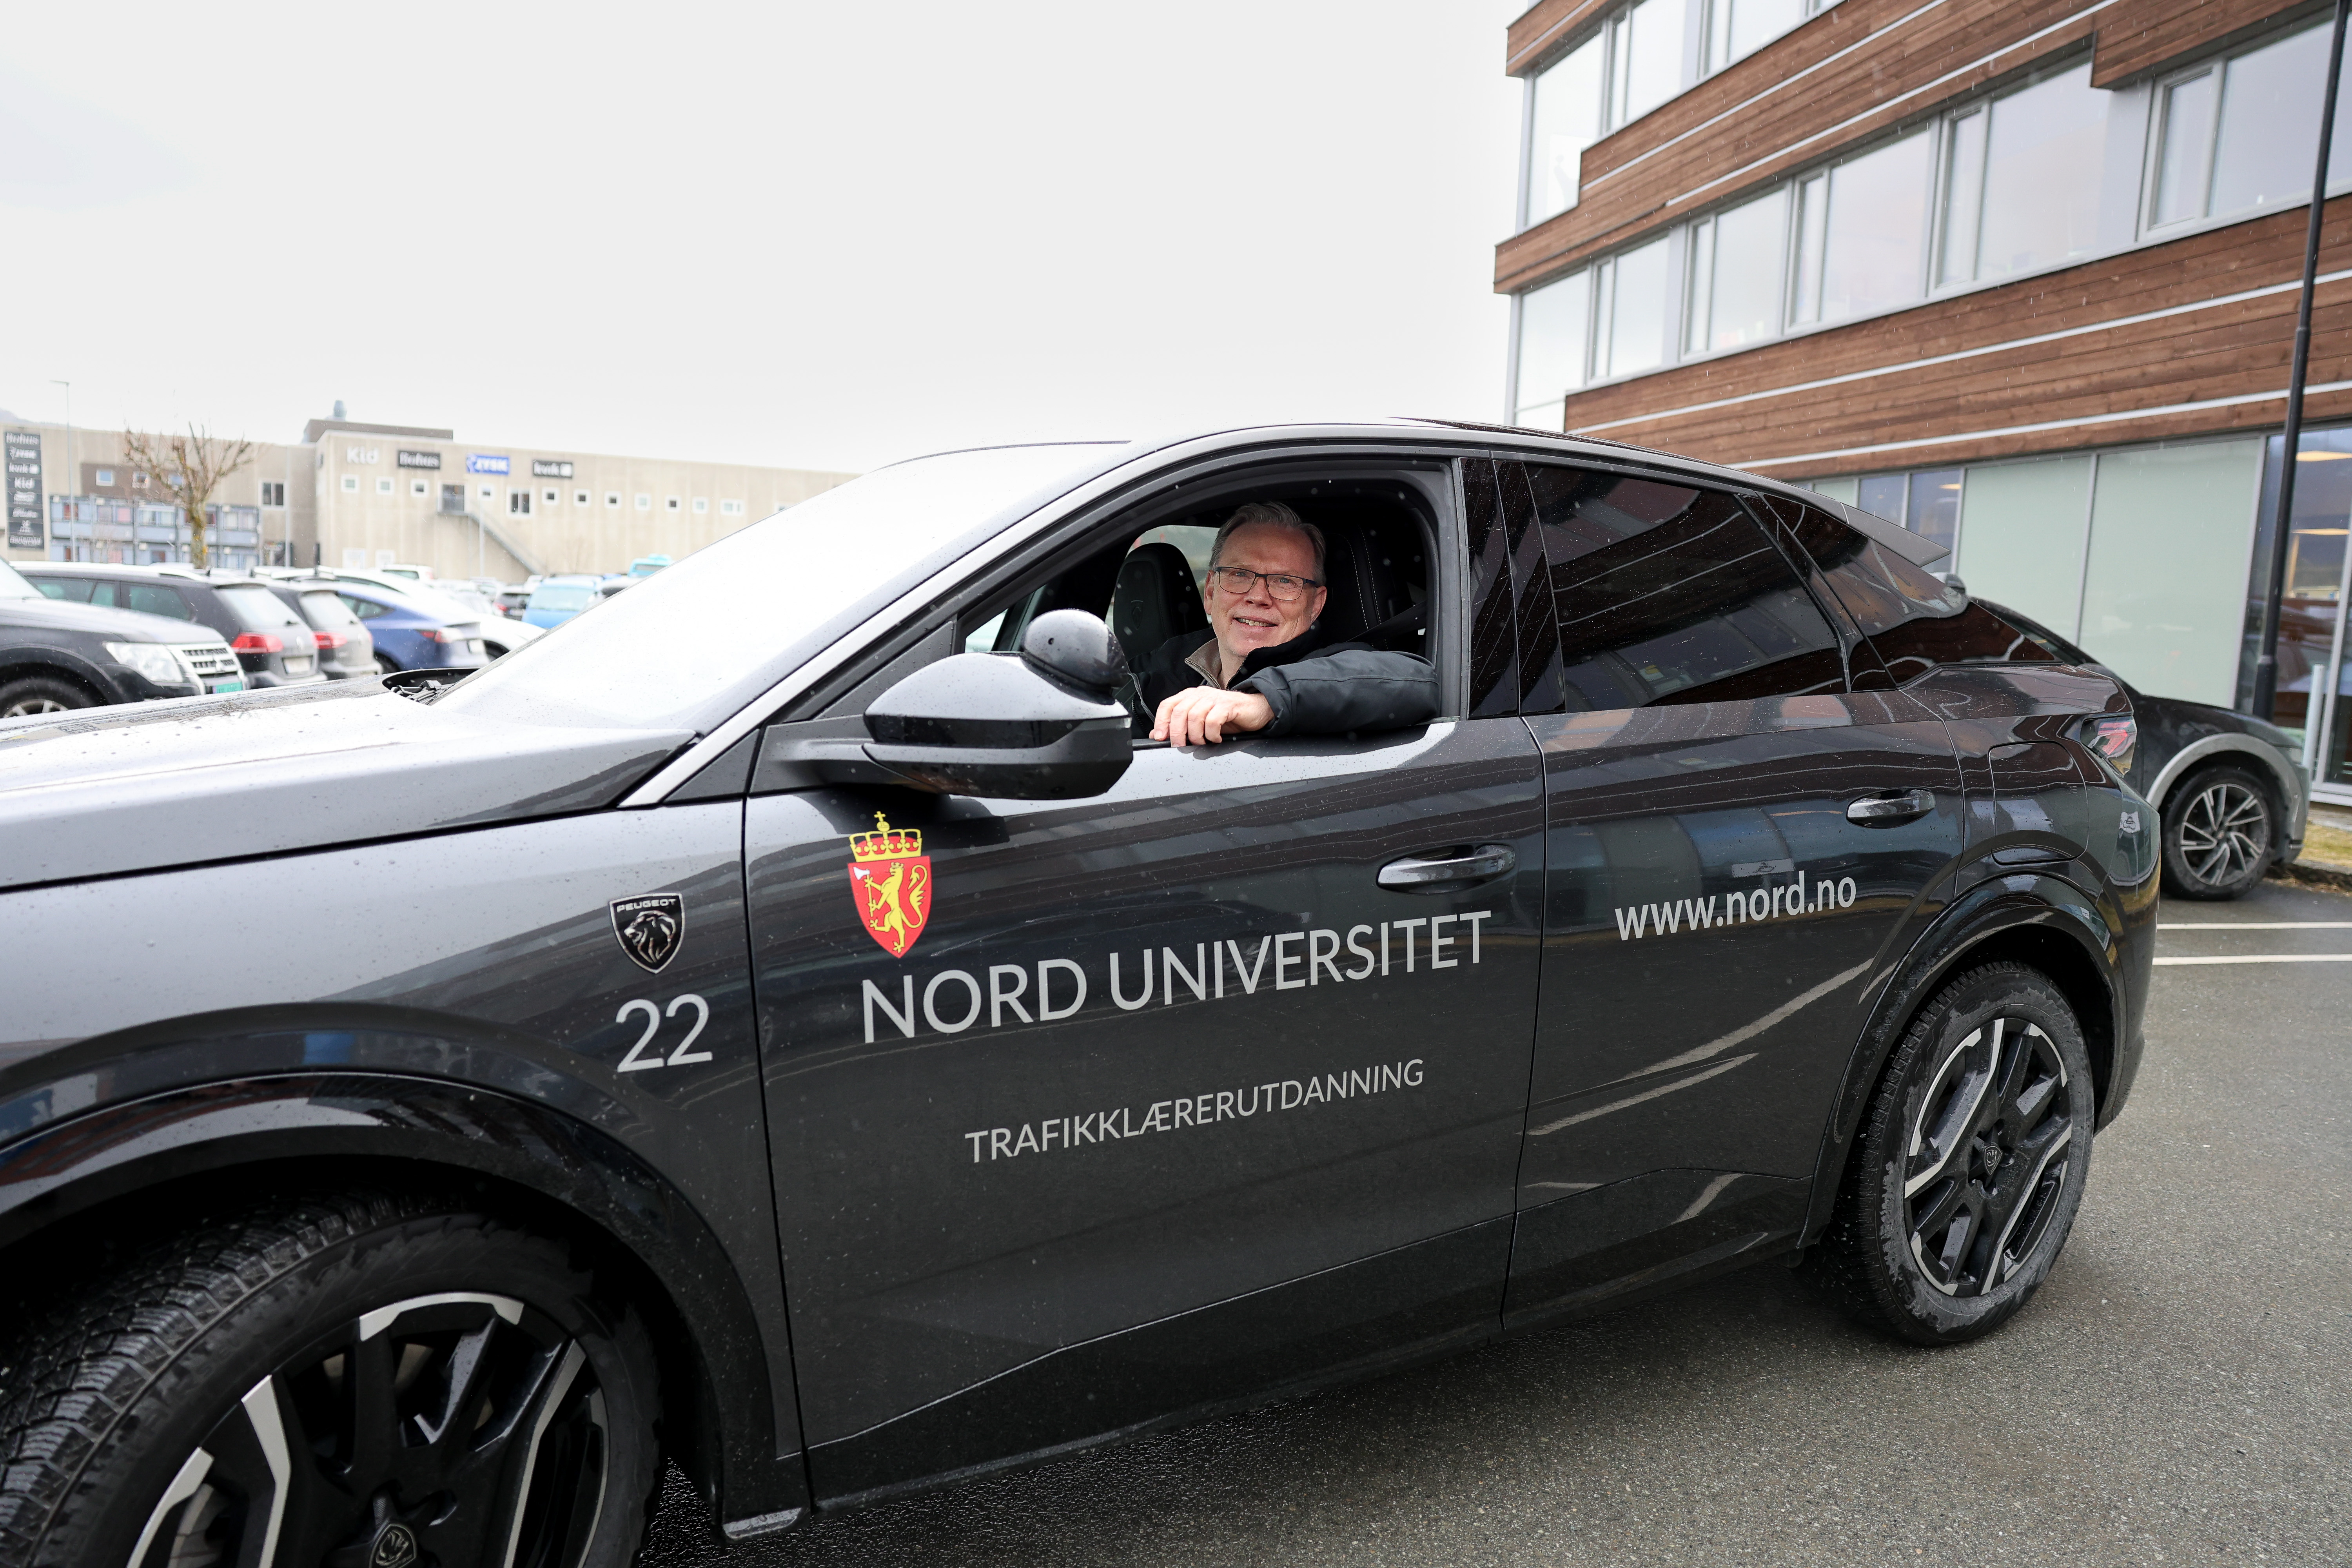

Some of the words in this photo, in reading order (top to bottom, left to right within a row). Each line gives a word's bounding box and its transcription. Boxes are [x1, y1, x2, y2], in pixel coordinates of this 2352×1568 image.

[346, 446, 379, 464] Kid
[399, 452, 439, 467] Bohus
[474, 457, 509, 471] JYSK
[617, 898, 676, 913] PEUGEOT
[1615, 870, 1856, 941] www.nord.no
[862, 958, 1087, 1044] NORD
[1110, 910, 1491, 1010] UNIVERSITET
[616, 994, 713, 1073] 22
[965, 1059, 1423, 1163] TRAFIKKLÆRERUTDANNING
